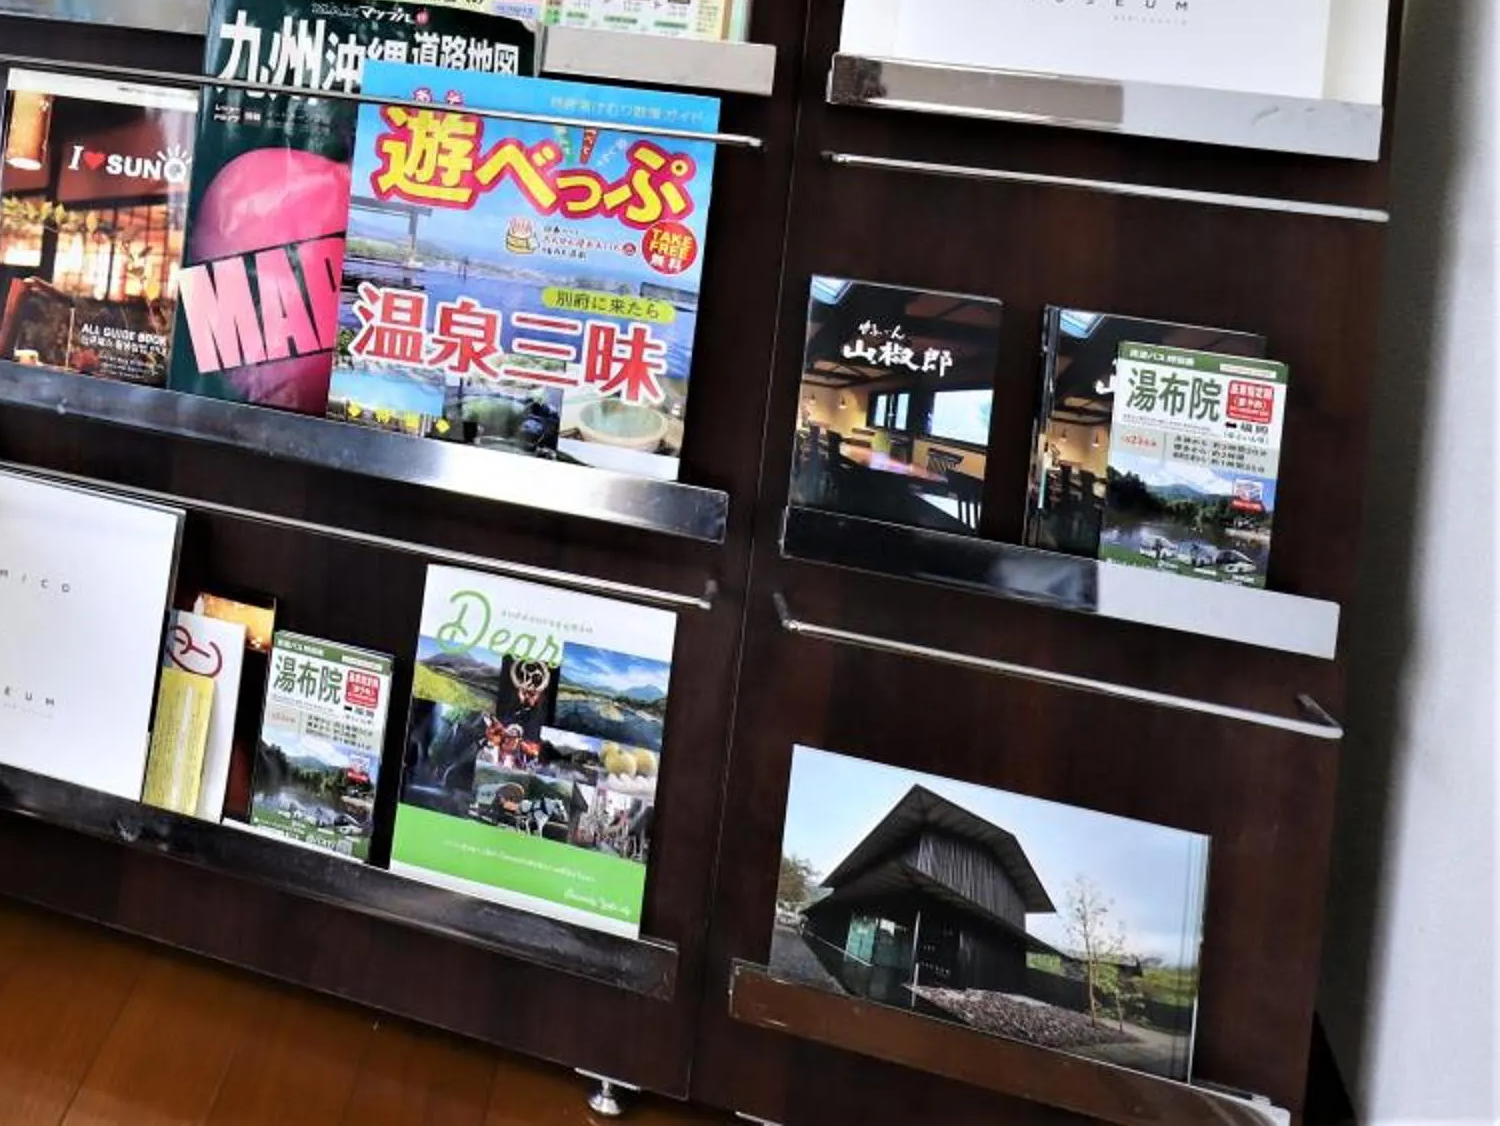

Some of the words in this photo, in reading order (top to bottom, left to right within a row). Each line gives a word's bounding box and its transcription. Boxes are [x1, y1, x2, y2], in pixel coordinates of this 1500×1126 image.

[70, 145, 84, 171] I
[378, 106, 688, 224] 遊べっぷ
[649, 239, 690, 260] FREE
[652, 228, 693, 250] TAKE
[556, 290, 660, 320] 別府に来たら
[81, 322, 100, 335] ALL
[1126, 368, 1222, 423] 湯布院
[436, 589, 563, 669] Dear
[273, 654, 343, 705] 湯布院
